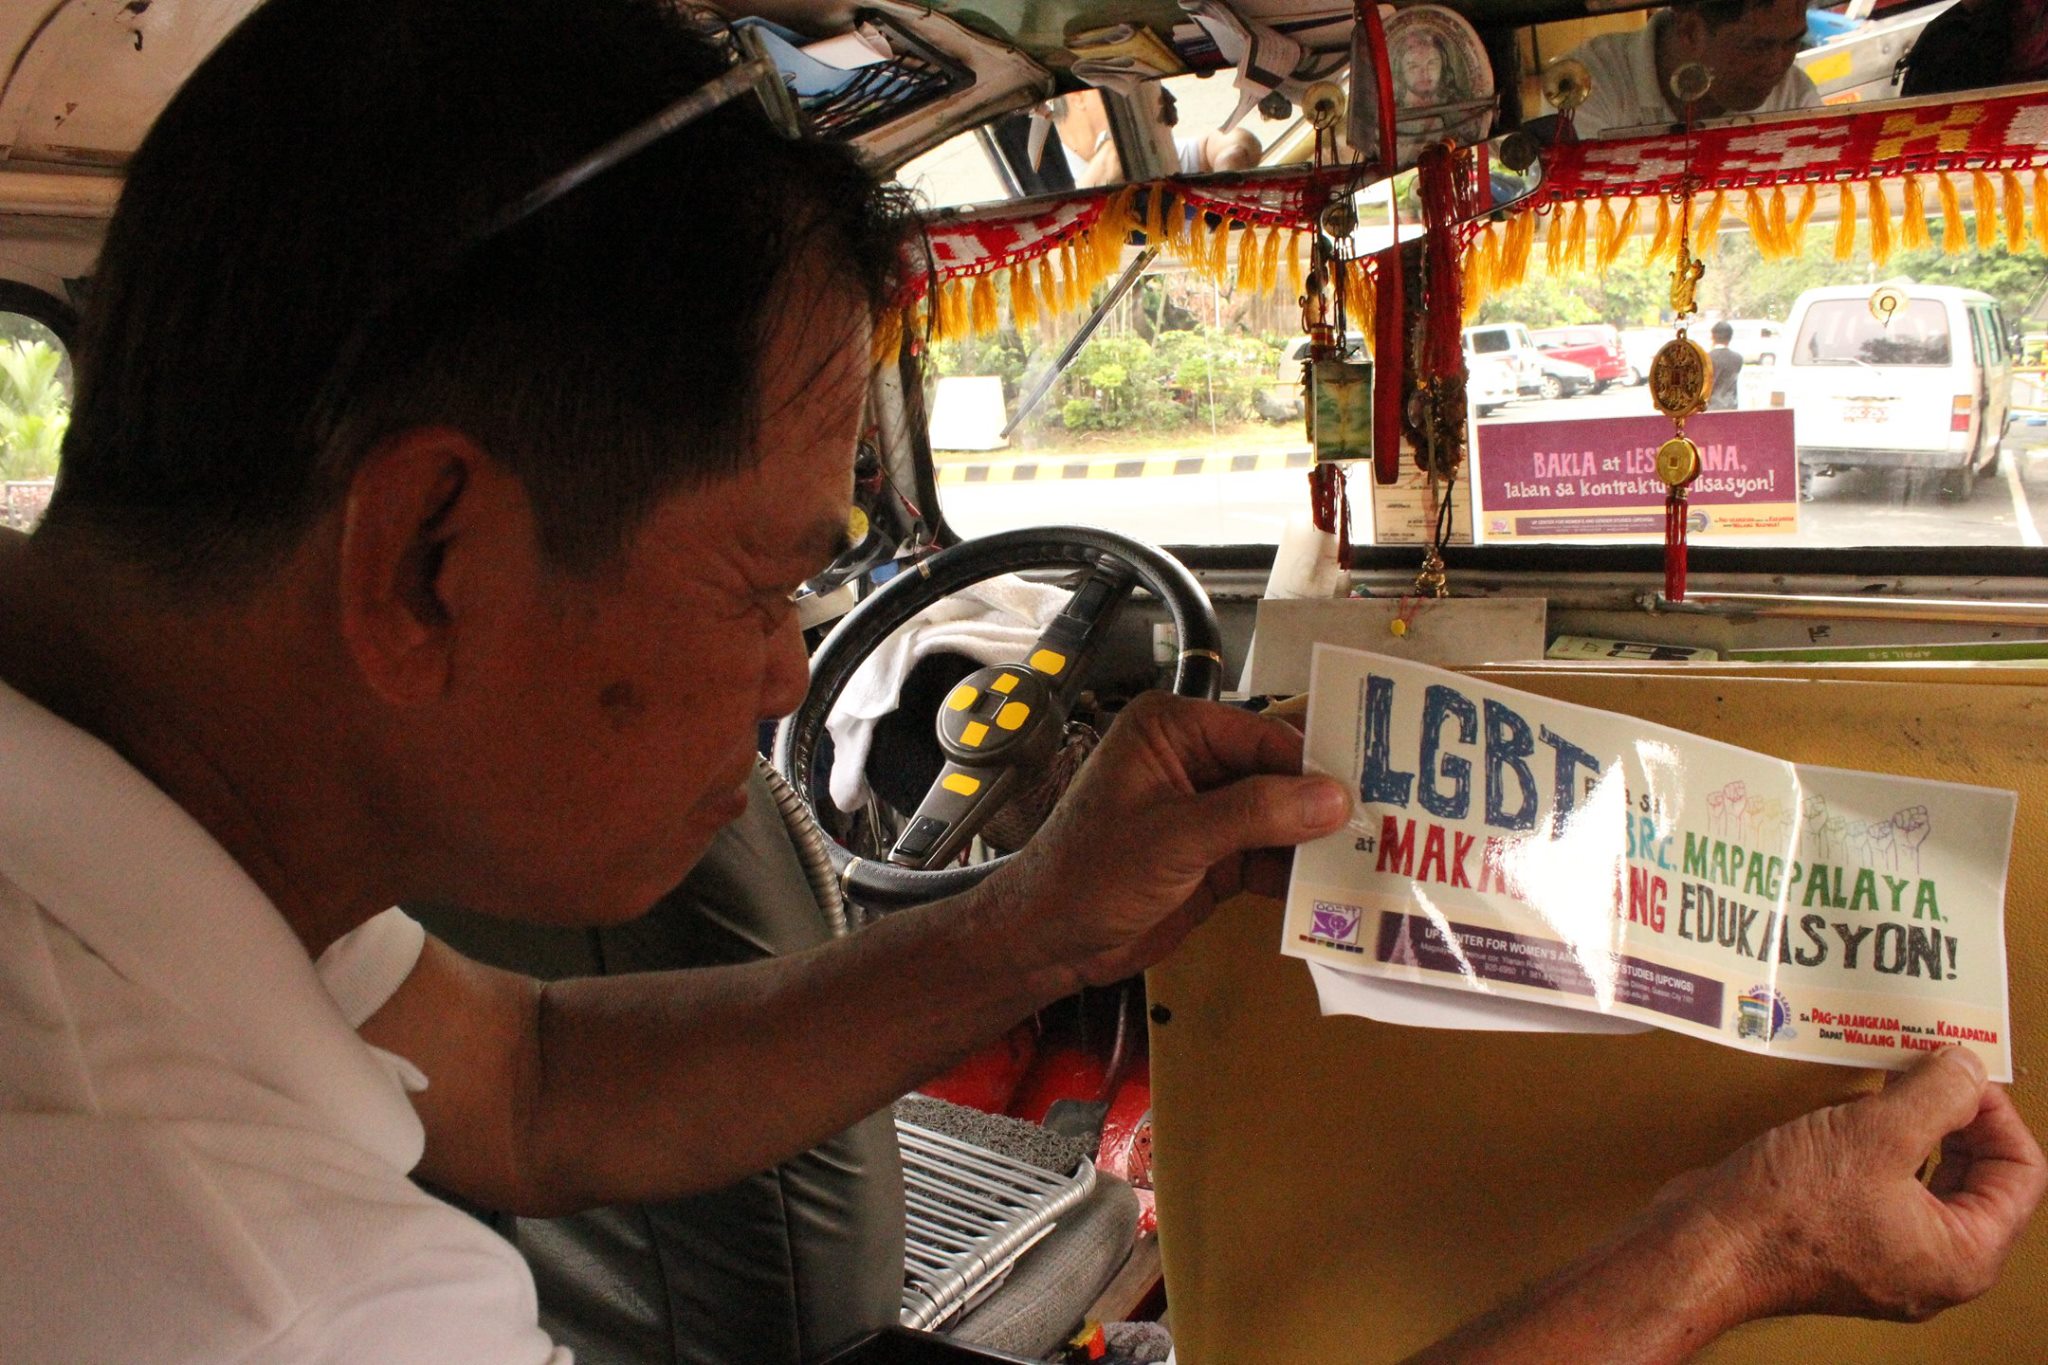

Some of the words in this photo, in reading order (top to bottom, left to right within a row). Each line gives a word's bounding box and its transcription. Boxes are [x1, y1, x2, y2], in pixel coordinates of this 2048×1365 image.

[1533, 451, 1597, 479] BAKLA
[1602, 456, 1621, 471] at
[1504, 481, 1551, 499] laban
[1555, 482, 1576, 498] sa
[1360, 672, 1600, 842] LGBT
[1355, 836, 1376, 853] at
[1678, 881, 1958, 981] EDUKASYON!
[1425, 927, 1441, 939] UP
[1485, 938, 1507, 952] FOR
[1509, 942, 1558, 960] WOMEN'S
[1621, 964, 1655, 982] STUDIES
[1655, 974, 1695, 994] (UPCWGS)
[1811, 1007, 1900, 1031] PAG-ARANGKADA
[1901, 1025, 1922, 1033] PARA
[1936, 1020, 1998, 1044] KARAPATAN
[1844, 1029, 1895, 1048] WALANG
